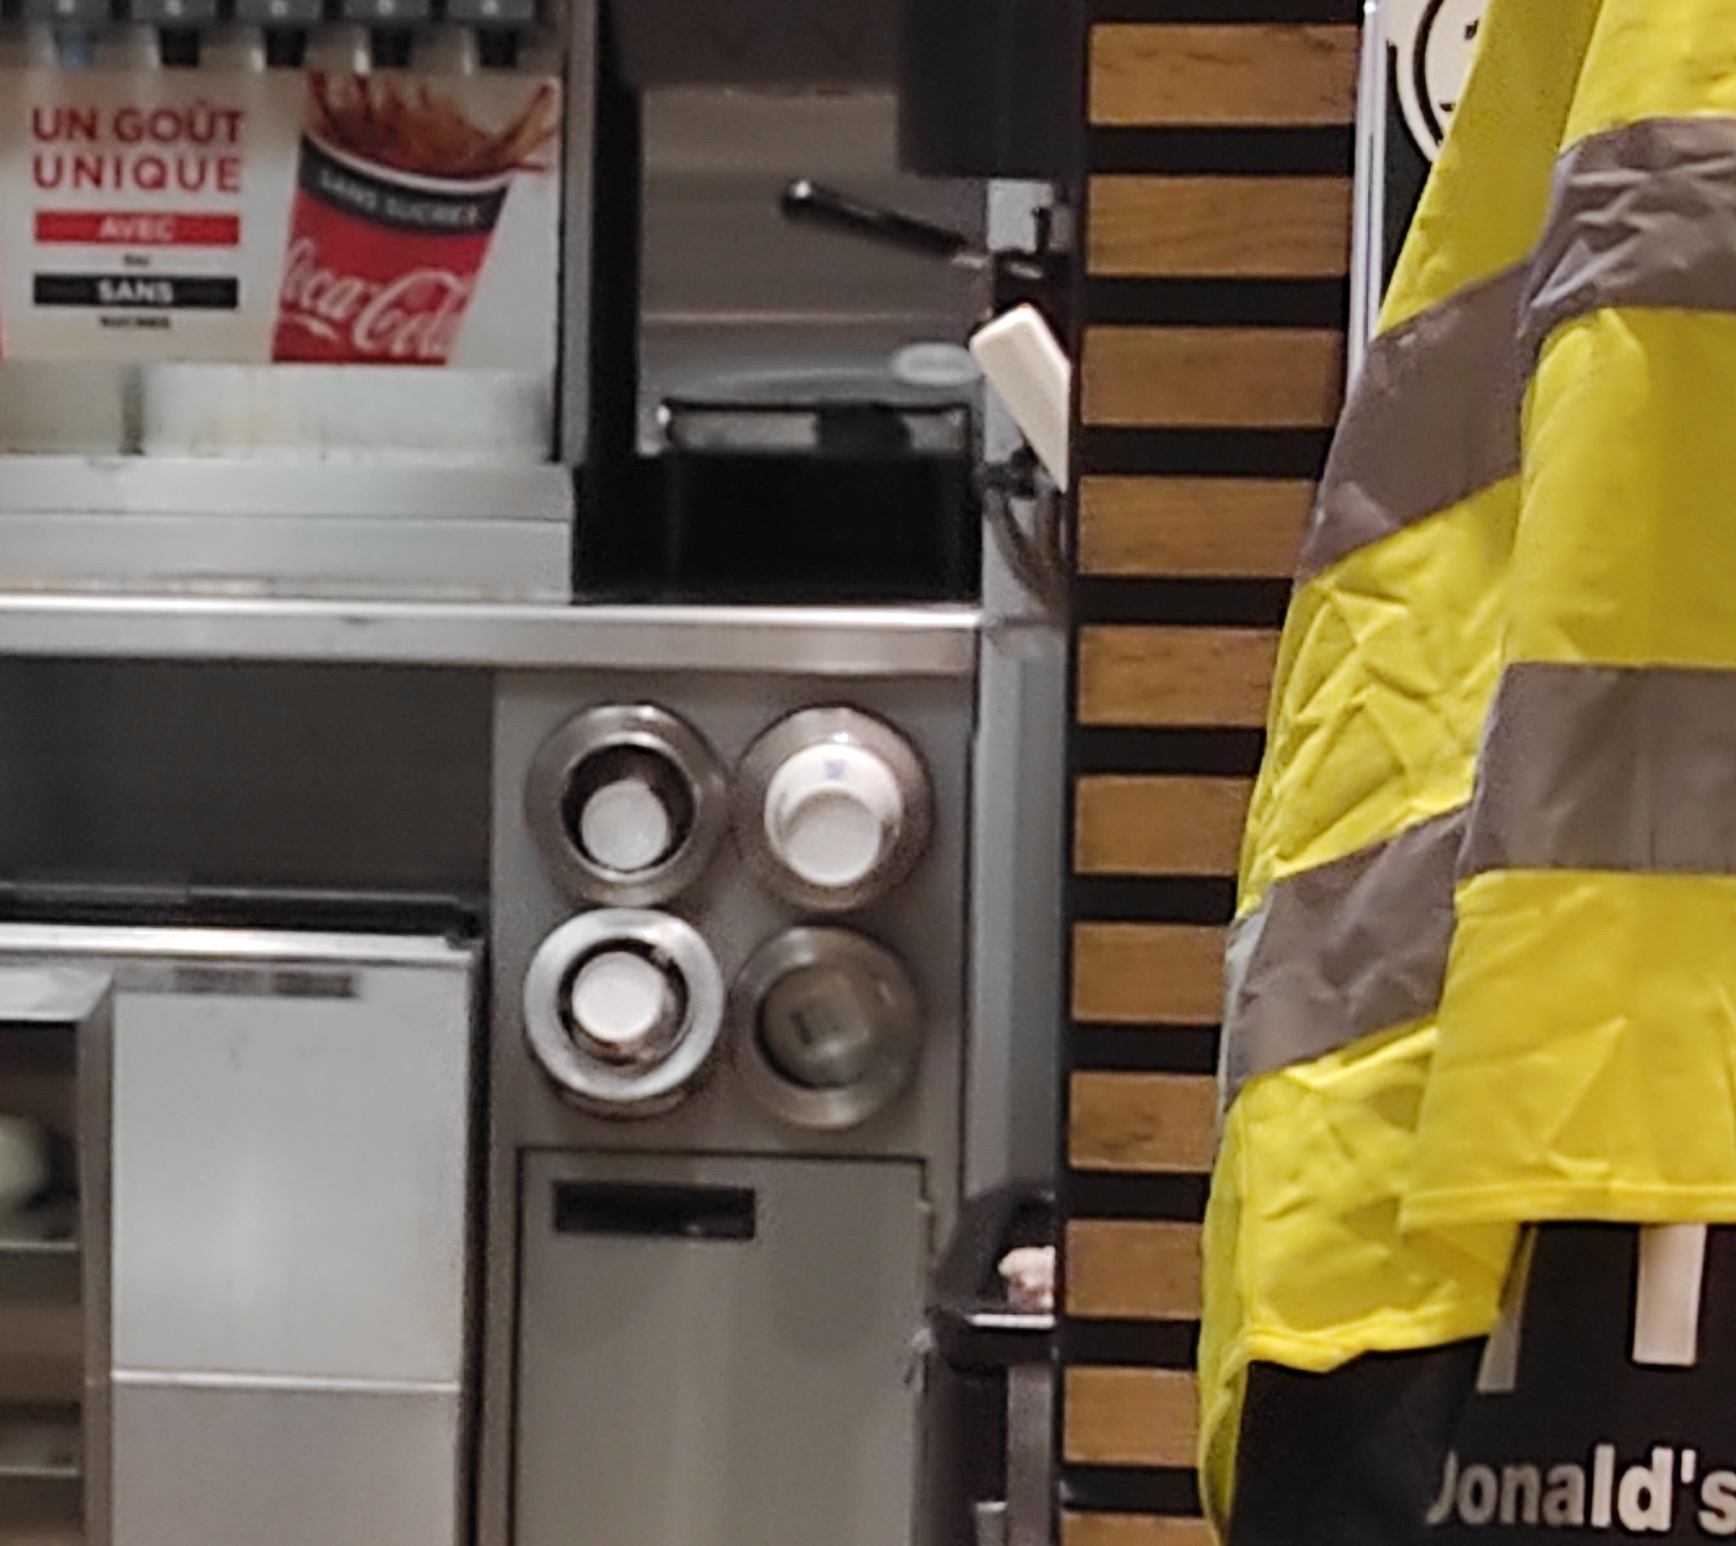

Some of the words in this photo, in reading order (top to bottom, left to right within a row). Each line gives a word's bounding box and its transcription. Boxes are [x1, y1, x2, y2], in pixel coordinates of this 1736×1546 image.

[32, 108, 98, 142] UN
[114, 98, 246, 144] GOÛT
[32, 155, 241, 192] UNIQUE
[99, 217, 174, 239] AVEC
[97, 279, 174, 303] SANS
